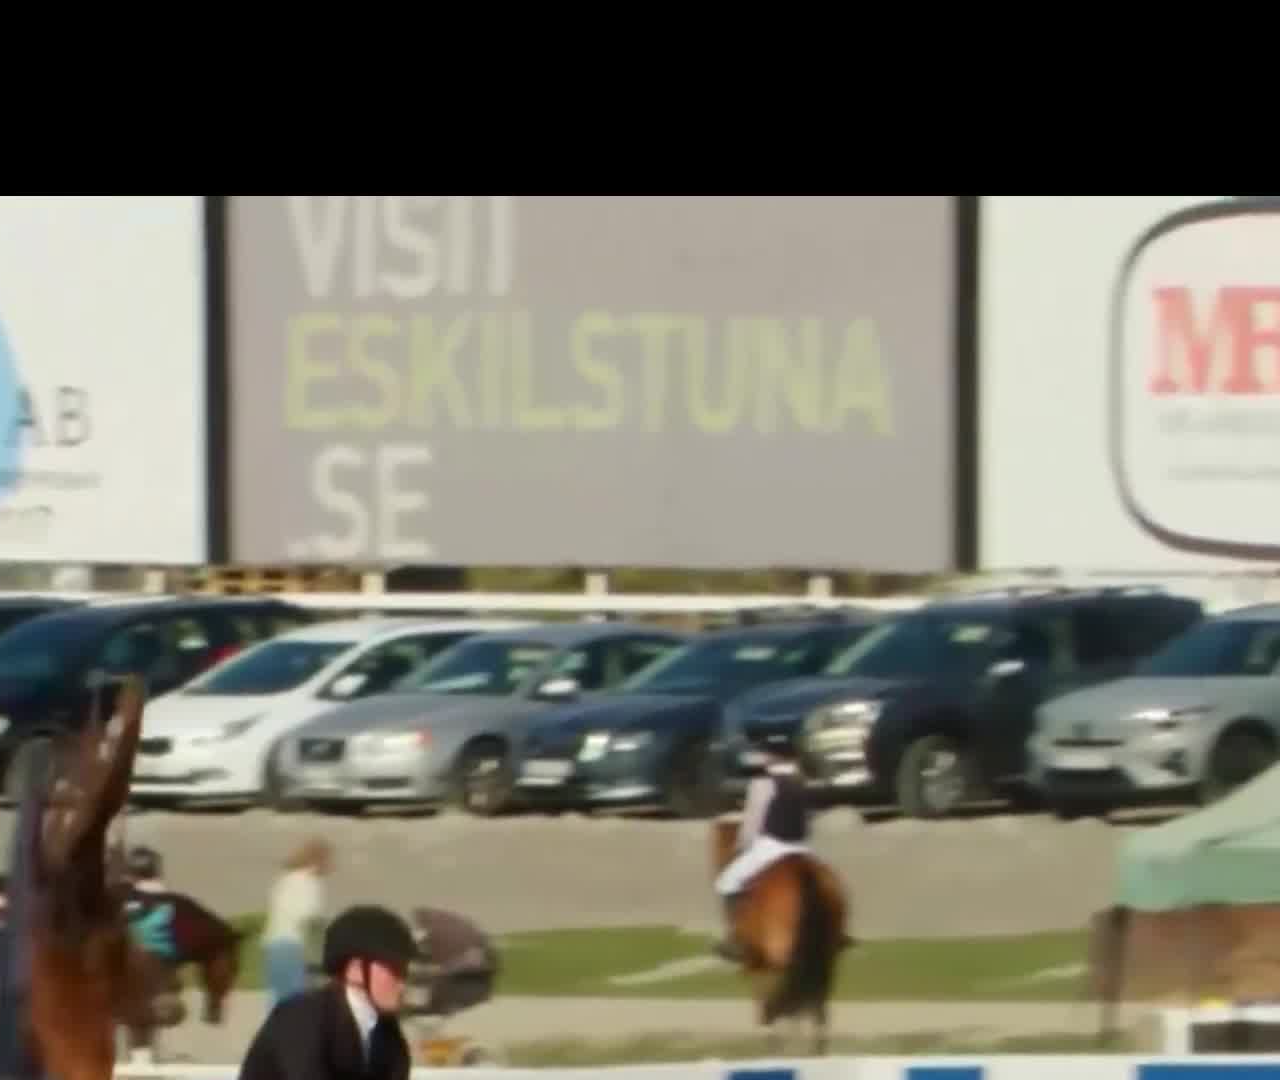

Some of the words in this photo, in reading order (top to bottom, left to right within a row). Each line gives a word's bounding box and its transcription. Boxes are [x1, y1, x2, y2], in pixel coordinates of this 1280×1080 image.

[3, 384, 92, 447] AB
[283, 308, 896, 437] ESKILSTUNA
[287, 440, 434, 561] .SE
